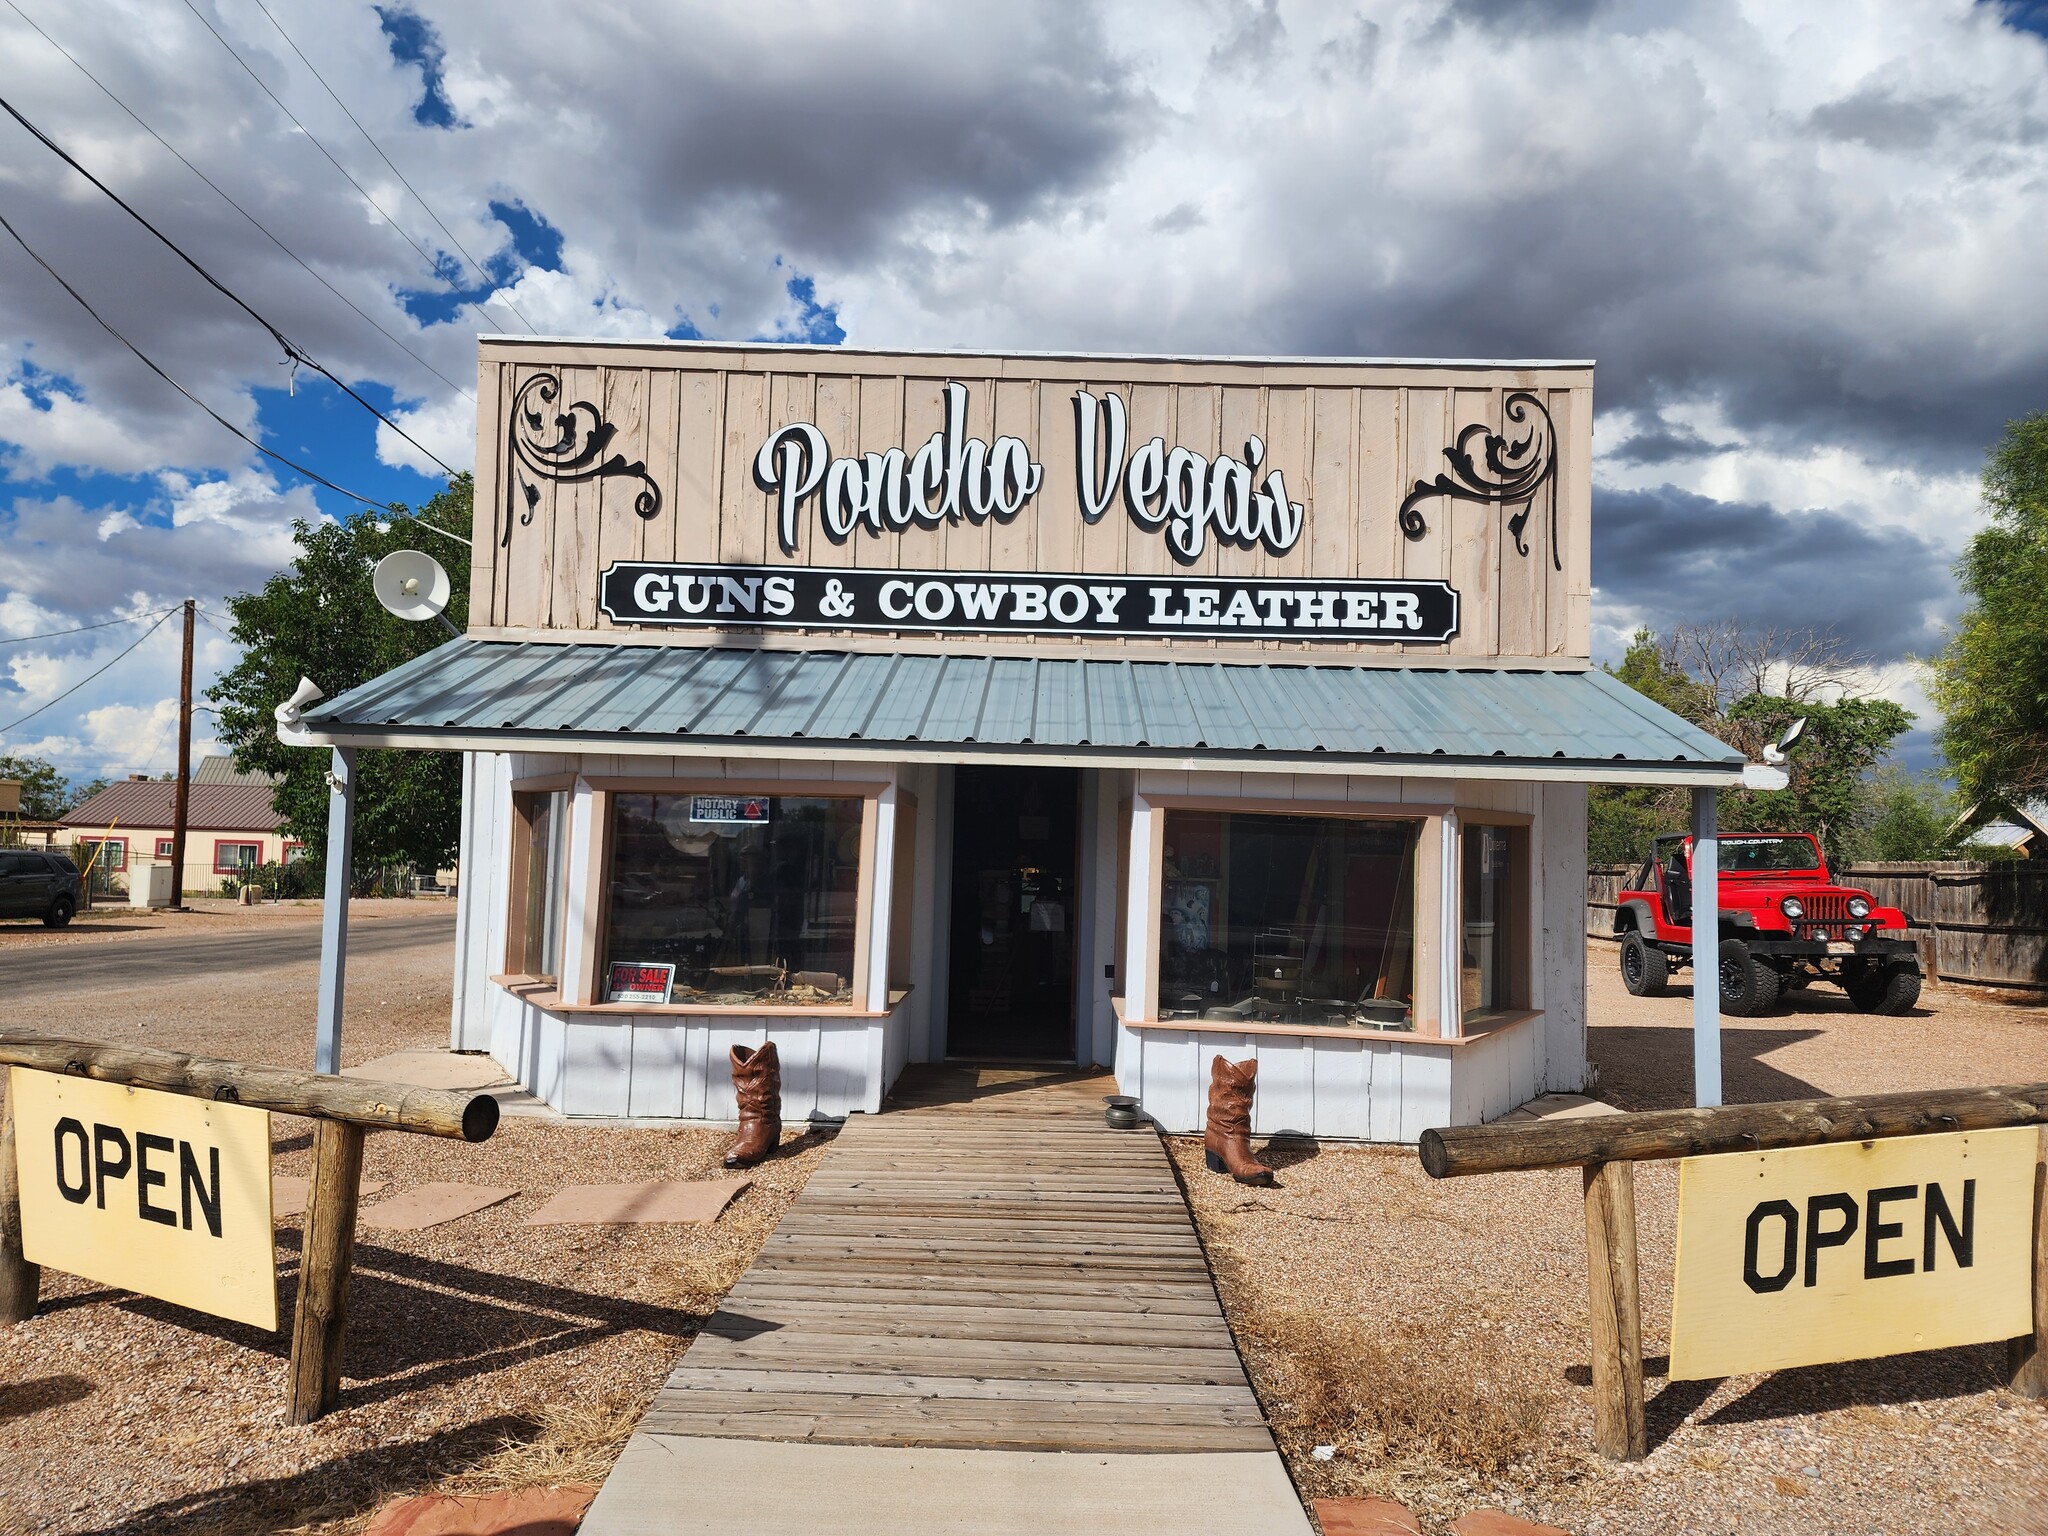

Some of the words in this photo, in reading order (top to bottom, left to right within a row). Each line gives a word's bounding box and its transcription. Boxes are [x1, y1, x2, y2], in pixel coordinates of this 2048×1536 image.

[754, 383, 1042, 556] Poncho
[1070, 390, 1306, 566] Vega's
[633, 573, 795, 616] GUNS
[818, 578, 855, 617] &
[878, 580, 1126, 624] COWBOY
[1148, 588, 1423, 630] LEATHER
[696, 809, 737, 819] PUBLIC
[697, 799, 738, 809] NOTARY
[613, 967, 636, 982] FOR
[639, 968, 668, 983] SALE
[629, 983, 664, 992] OWNER
[54, 1116, 223, 1239] OPEN
[1743, 1178, 1976, 1294] OPEN
